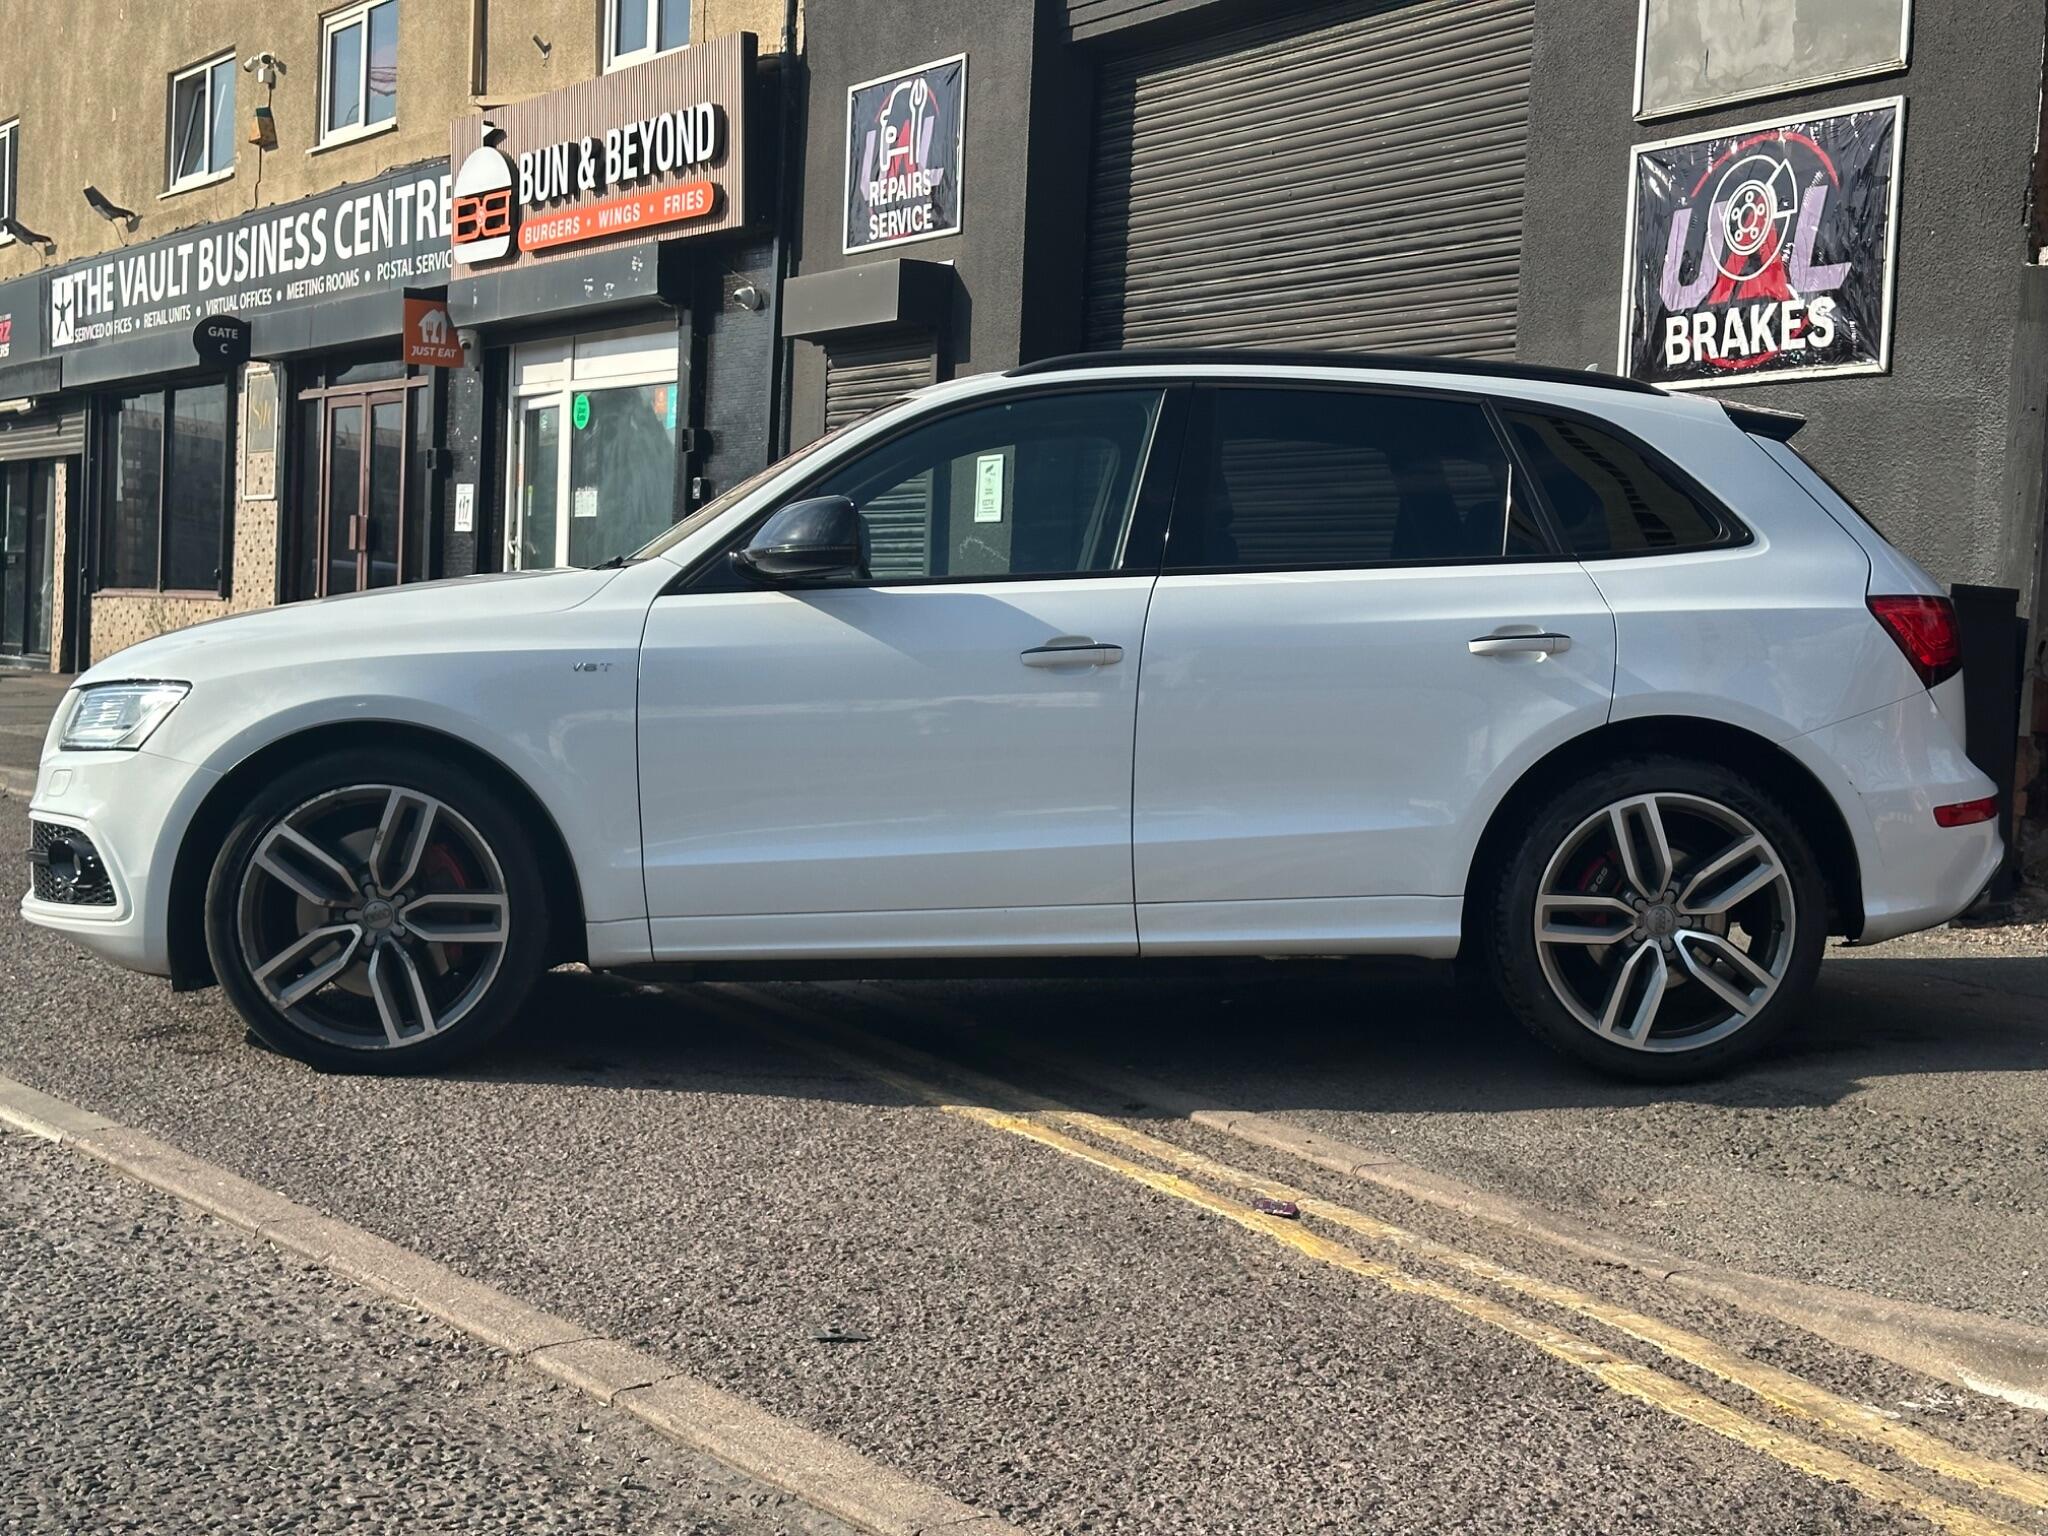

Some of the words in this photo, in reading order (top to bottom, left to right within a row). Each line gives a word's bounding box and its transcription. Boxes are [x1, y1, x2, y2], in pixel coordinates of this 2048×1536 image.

[519, 143, 570, 205] BUN
[577, 135, 596, 192] &
[605, 101, 715, 185] BEYOND
[869, 168, 933, 207] REPAIRS
[524, 216, 580, 245] BURGERS
[598, 202, 641, 229] WINGS
[663, 188, 704, 216] FRIES
[869, 202, 933, 241] SERVICE
[74, 262, 114, 319] THE
[119, 242, 194, 308] VAULT
[198, 207, 327, 292] BUSINESS
[334, 174, 452, 260] CENTRE
[74, 322, 104, 344] SERVICED
[143, 308, 168, 329] RETAIL
[168, 303, 191, 324] UNITS
[205, 294, 239, 316] VIRTUAL
[239, 288, 272, 310] OFFICES
[286, 276, 325, 301] MEETING
[325, 268, 360, 293] ROOMS
[377, 257, 415, 282] POSTAL
[208, 326, 239, 340] GATE
[220, 343, 229, 354] C
[411, 345, 436, 357] JUST
[437, 347, 458, 359] EAT
[1665, 295, 1837, 368] BRAKES
